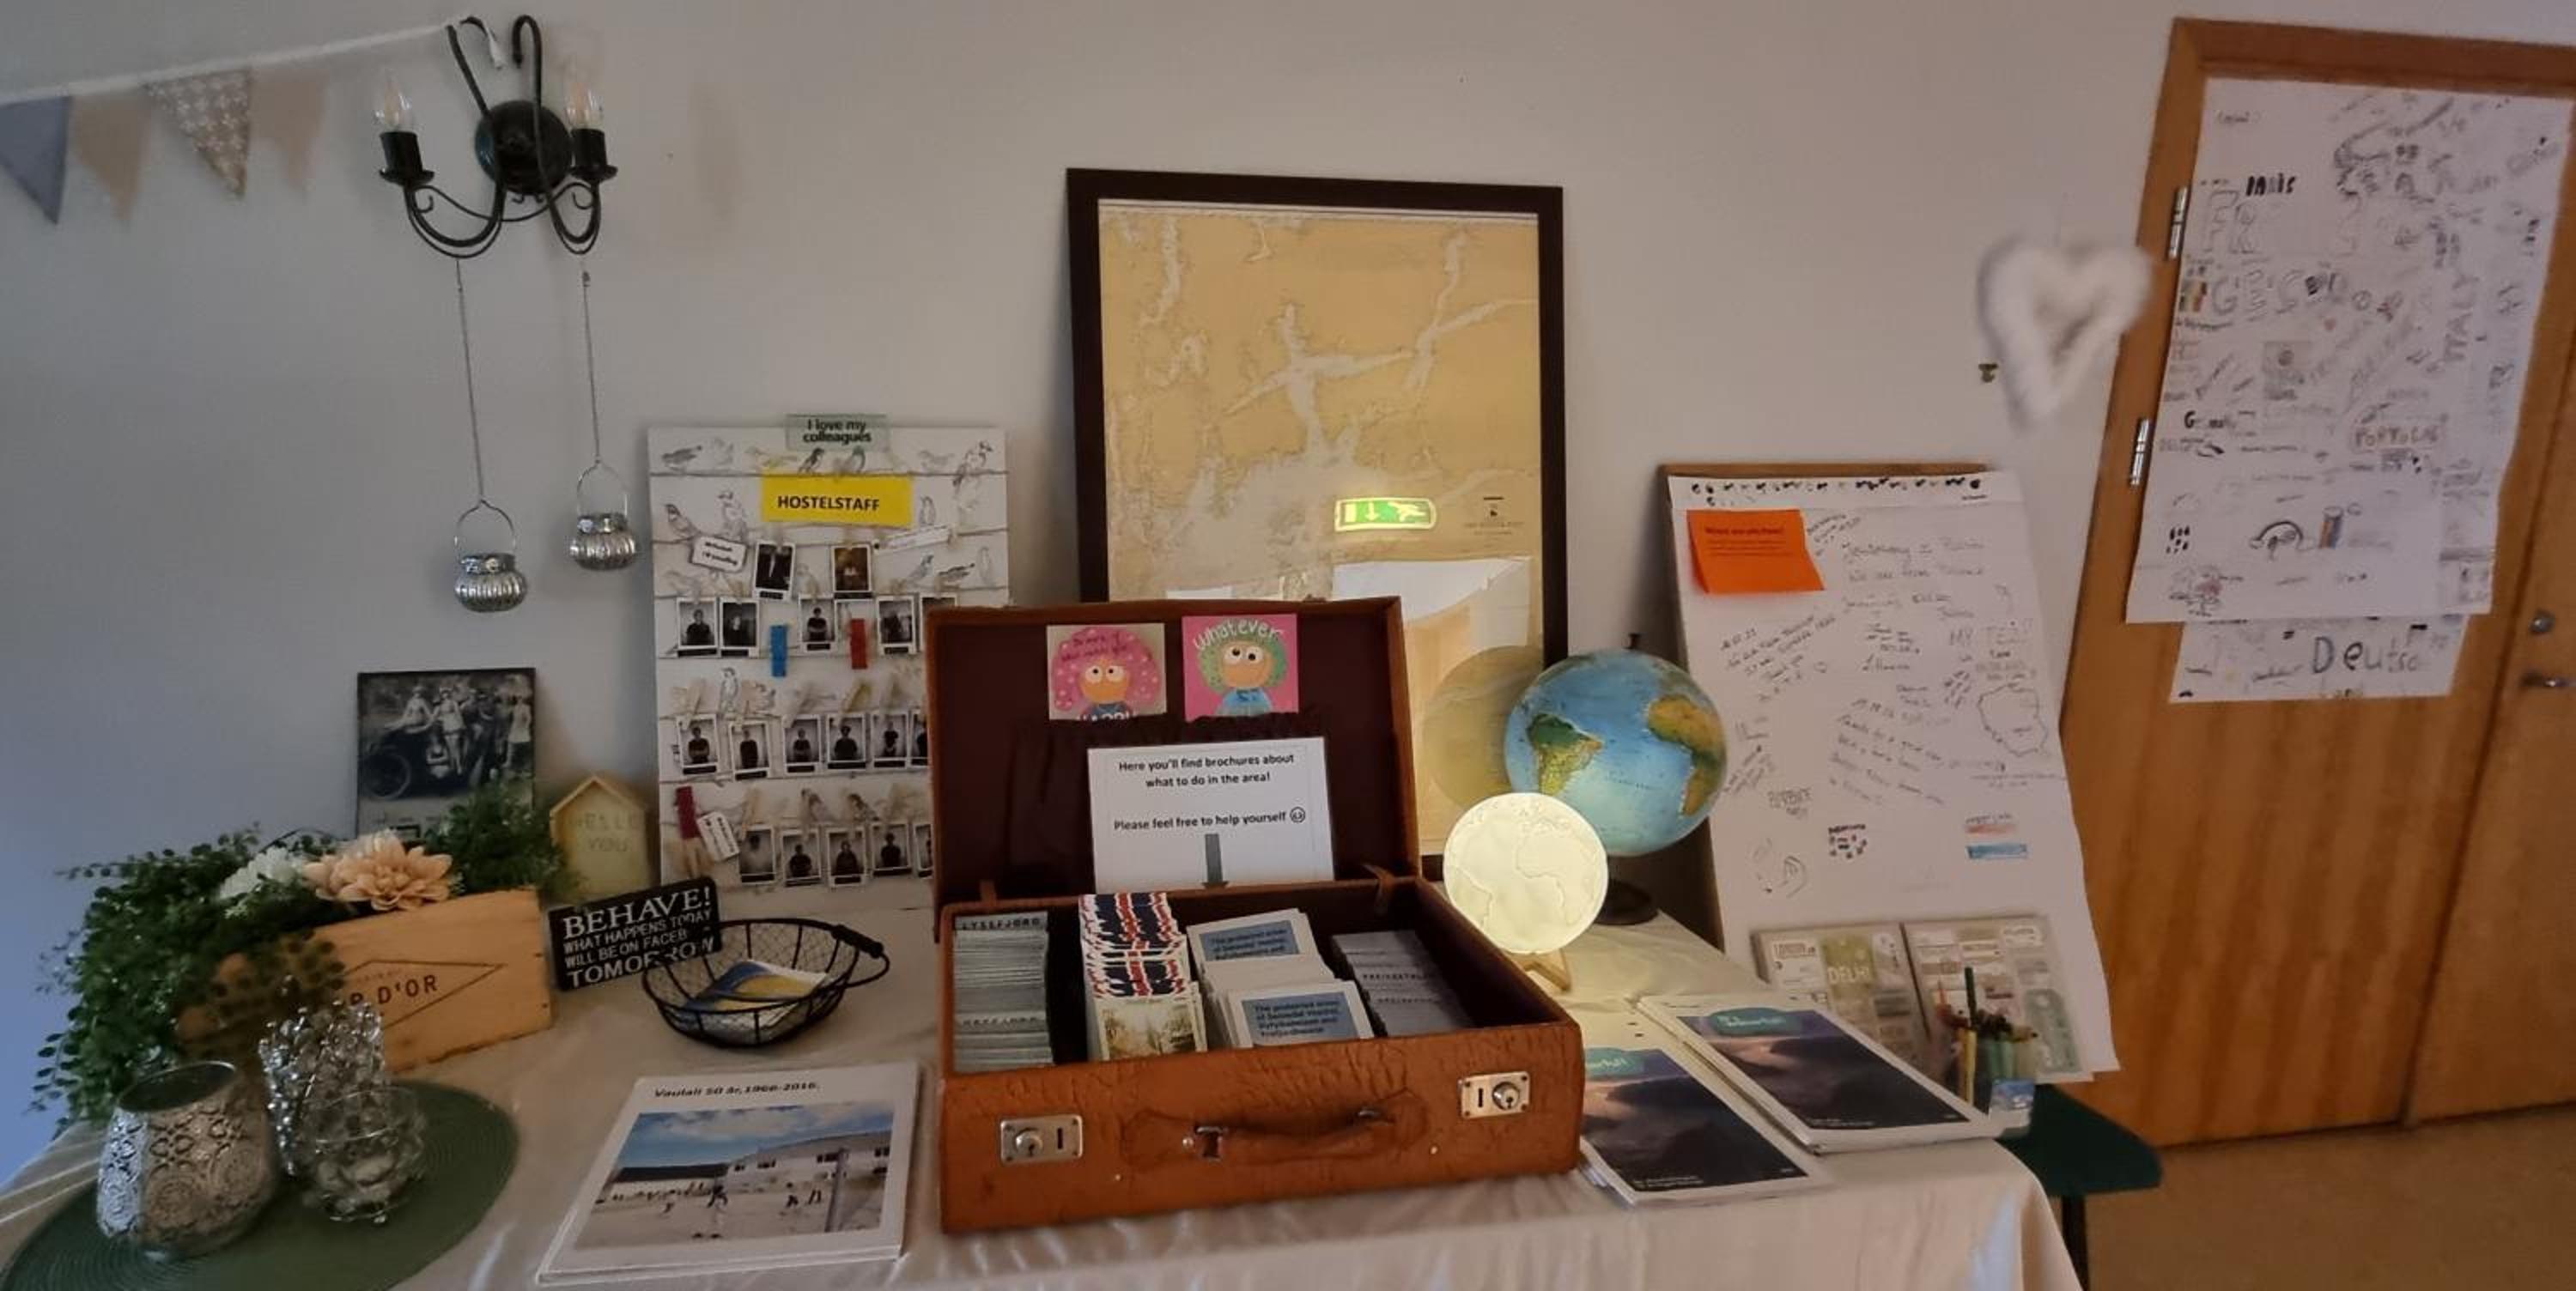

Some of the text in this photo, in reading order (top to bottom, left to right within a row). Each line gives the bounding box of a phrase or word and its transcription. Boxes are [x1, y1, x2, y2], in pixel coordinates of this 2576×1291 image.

[815, 418, 843, 430] love
[846, 421, 866, 433] my
[803, 431, 872, 445] colleagues
[777, 495, 880, 512] HOSTELSTAFF
[1119, 755, 1294, 773] Here you'll find brochures about
[1145, 772, 1270, 788] what to do in the area!
[1115, 811, 1286, 831] Please feel free to help yourself
[563, 886, 711, 940] BEHAVE!
[564, 908, 712, 955] WHAT HAPPENS TODAY
[564, 952, 597, 970] WILL
[598, 947, 618, 961] BE
[619, 941, 639, 955] ON
[378, 974, 438, 1005] D'OR
